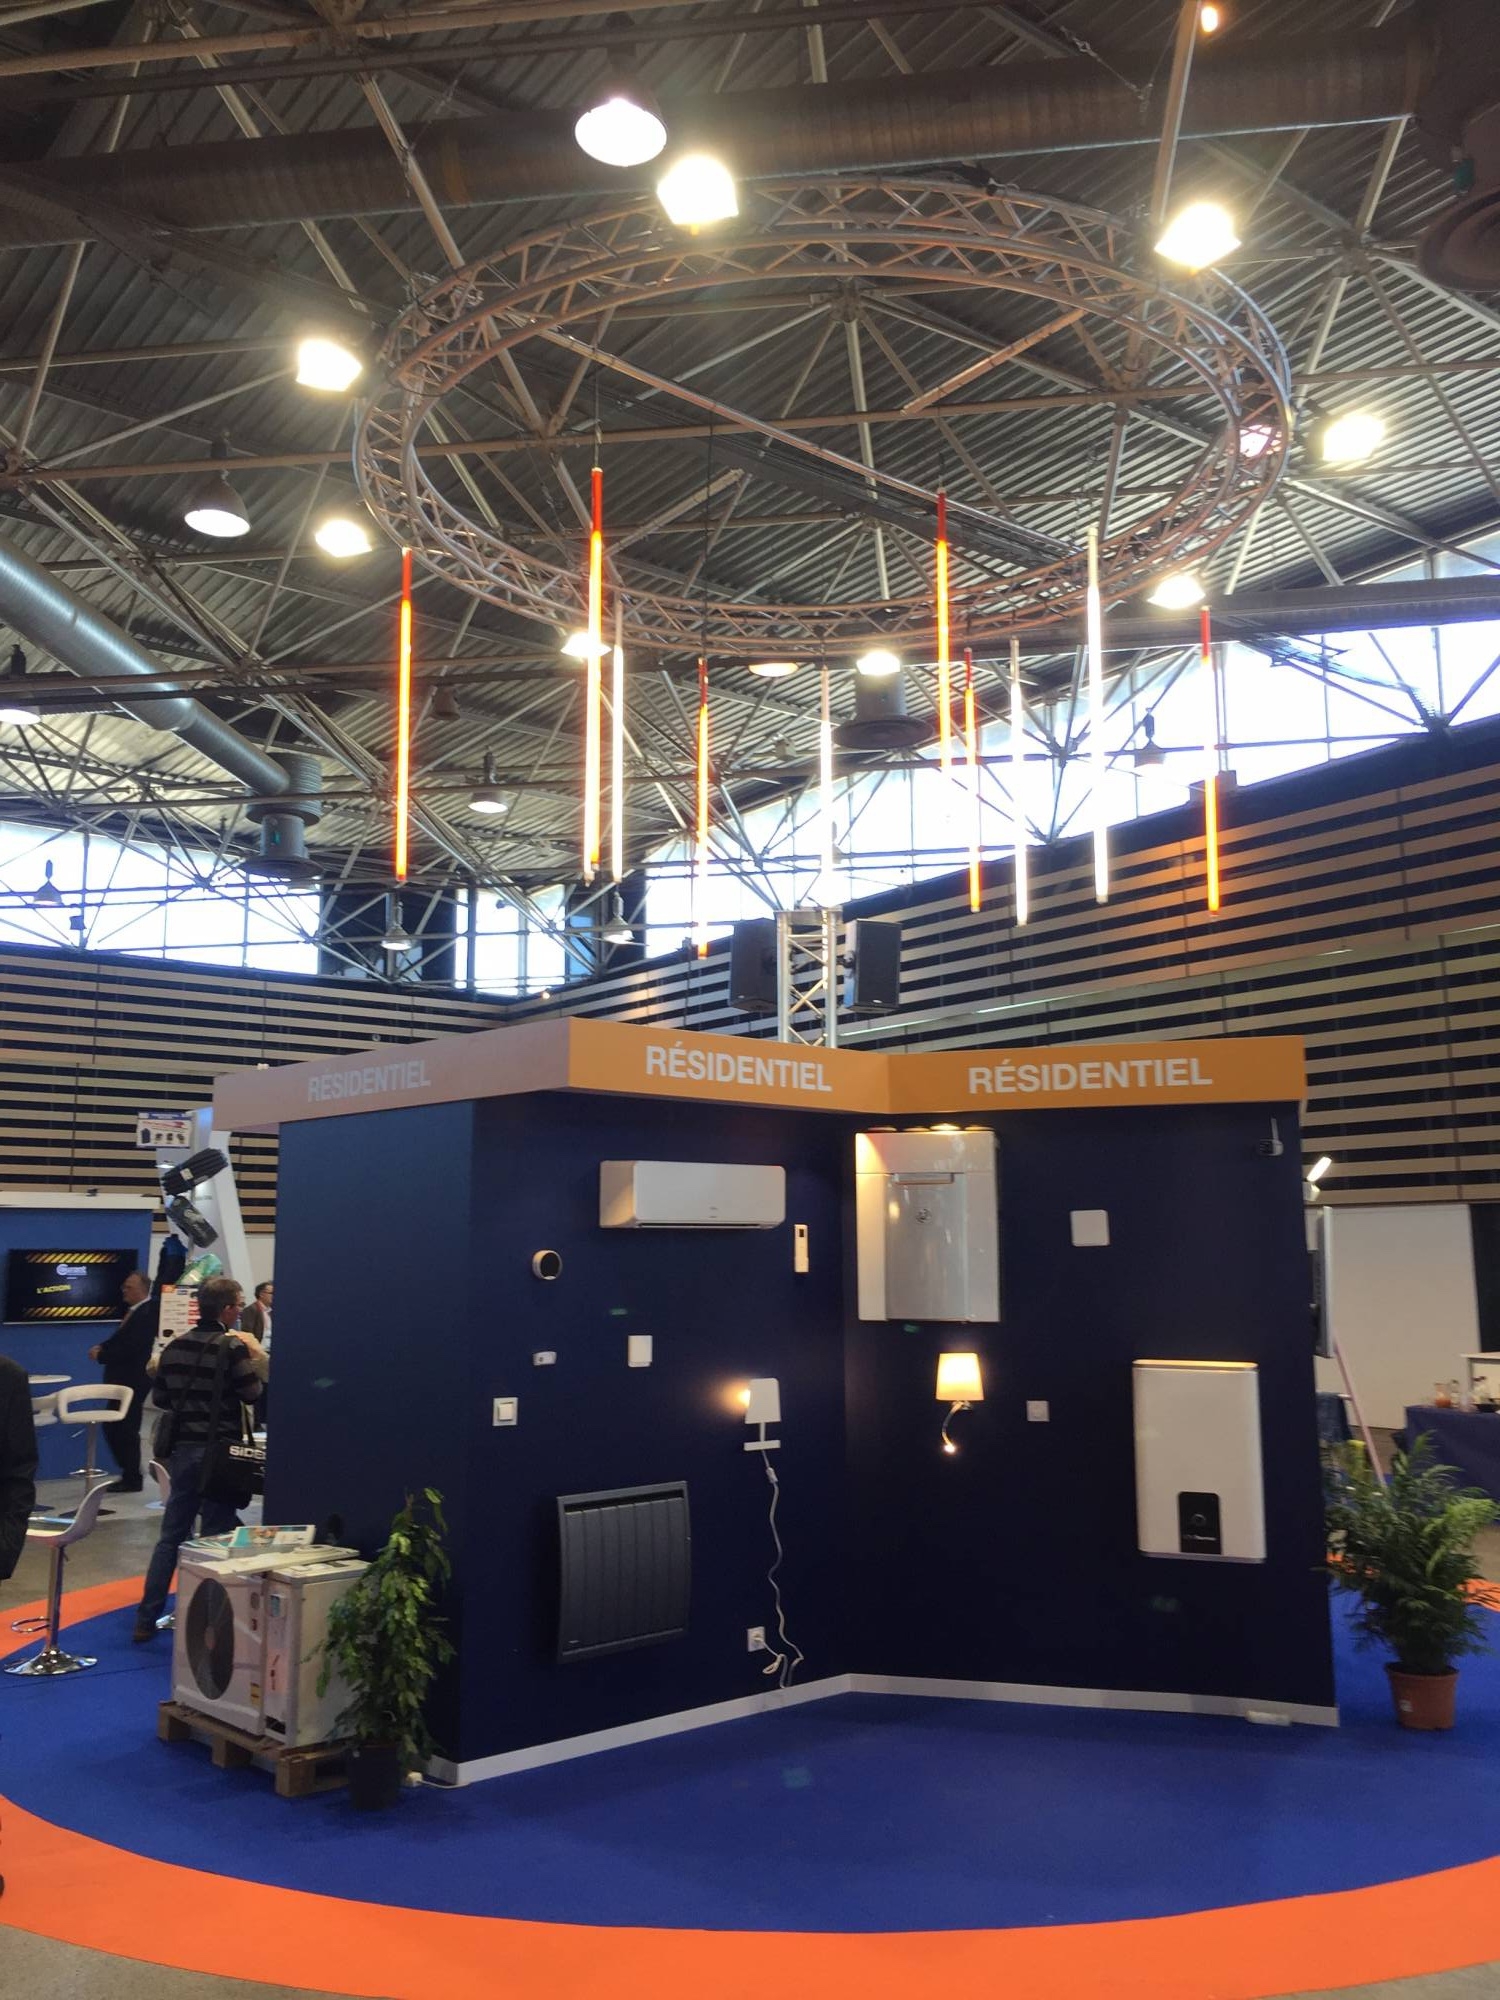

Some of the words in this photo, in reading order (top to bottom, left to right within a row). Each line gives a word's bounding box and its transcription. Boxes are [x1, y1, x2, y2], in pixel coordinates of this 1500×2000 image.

[307, 1059, 432, 1103] RÉSIDENTIEL
[645, 1041, 833, 1092] RÉSIDENTIEL
[968, 1058, 1213, 1095] RÉSIDENTIEL
